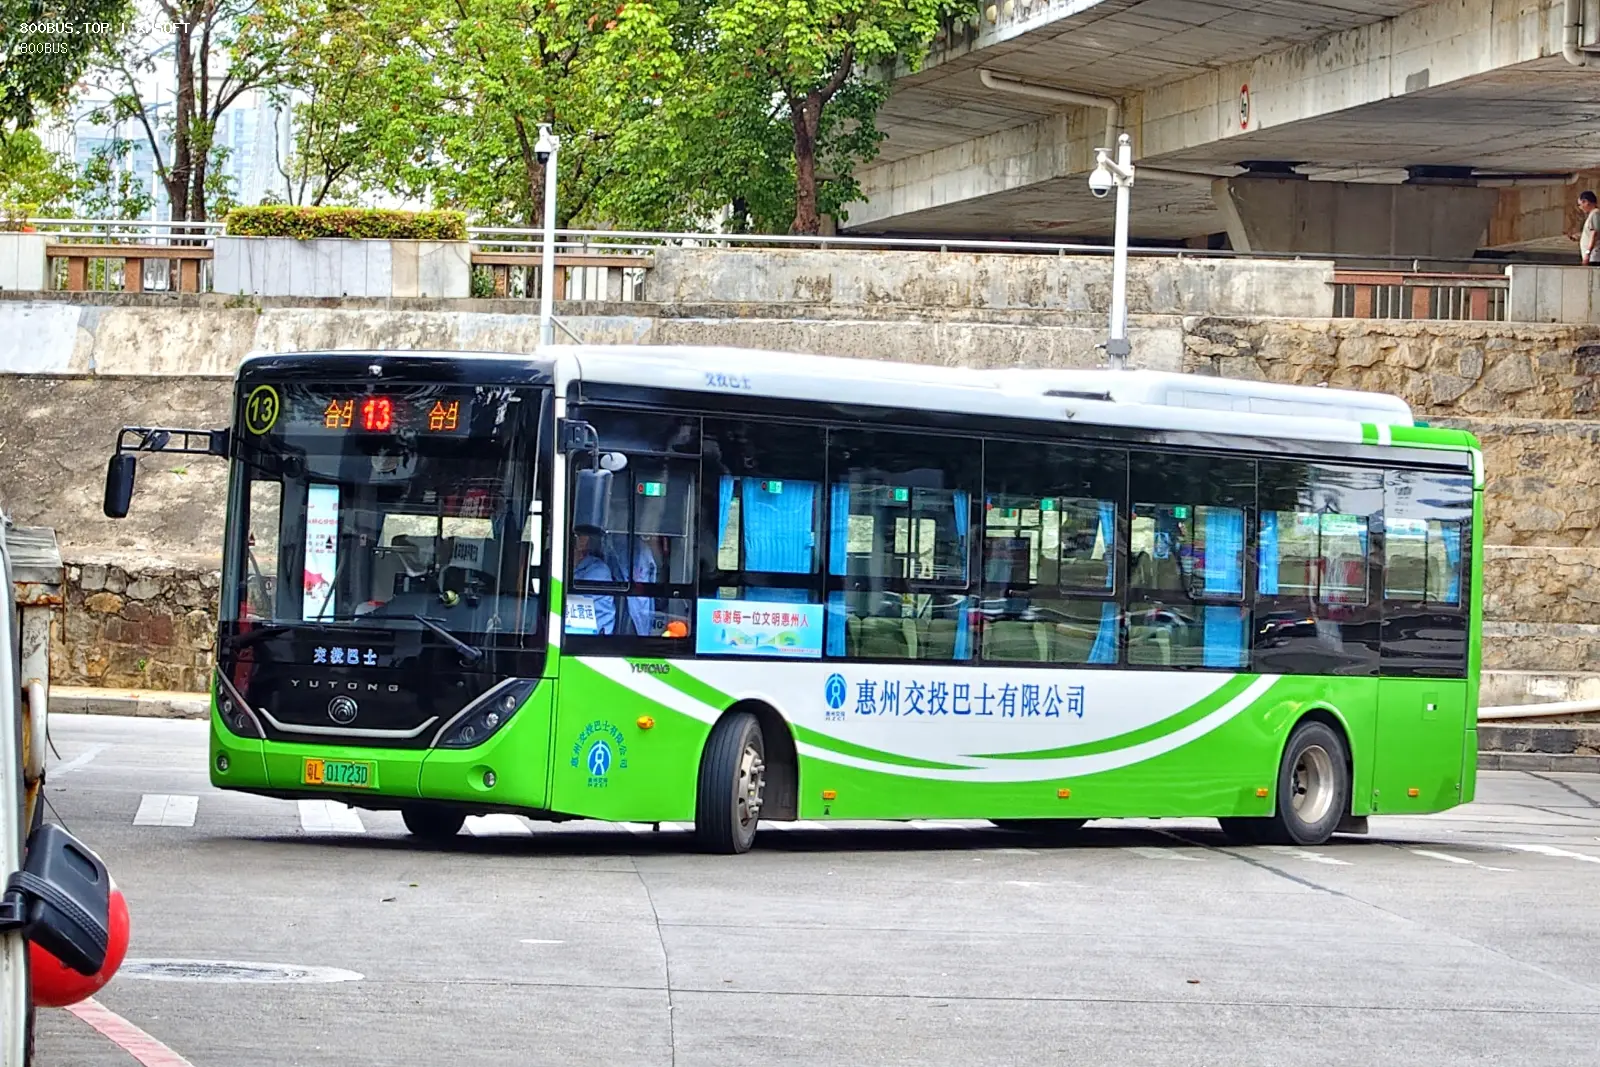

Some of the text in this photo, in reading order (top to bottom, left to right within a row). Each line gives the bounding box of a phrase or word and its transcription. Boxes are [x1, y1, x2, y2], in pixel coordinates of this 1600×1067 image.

[250, 396, 273, 422] 13
[363, 399, 391, 430] 13
[712, 610, 809, 628] 感谢每一位文明惠州人
[630, 663, 671, 675] YUTONG
[291, 679, 399, 692] YUTONG
[854, 678, 1085, 719] 惠州交投巴士有限公司
[326, 764, 368, 784] 01723D
